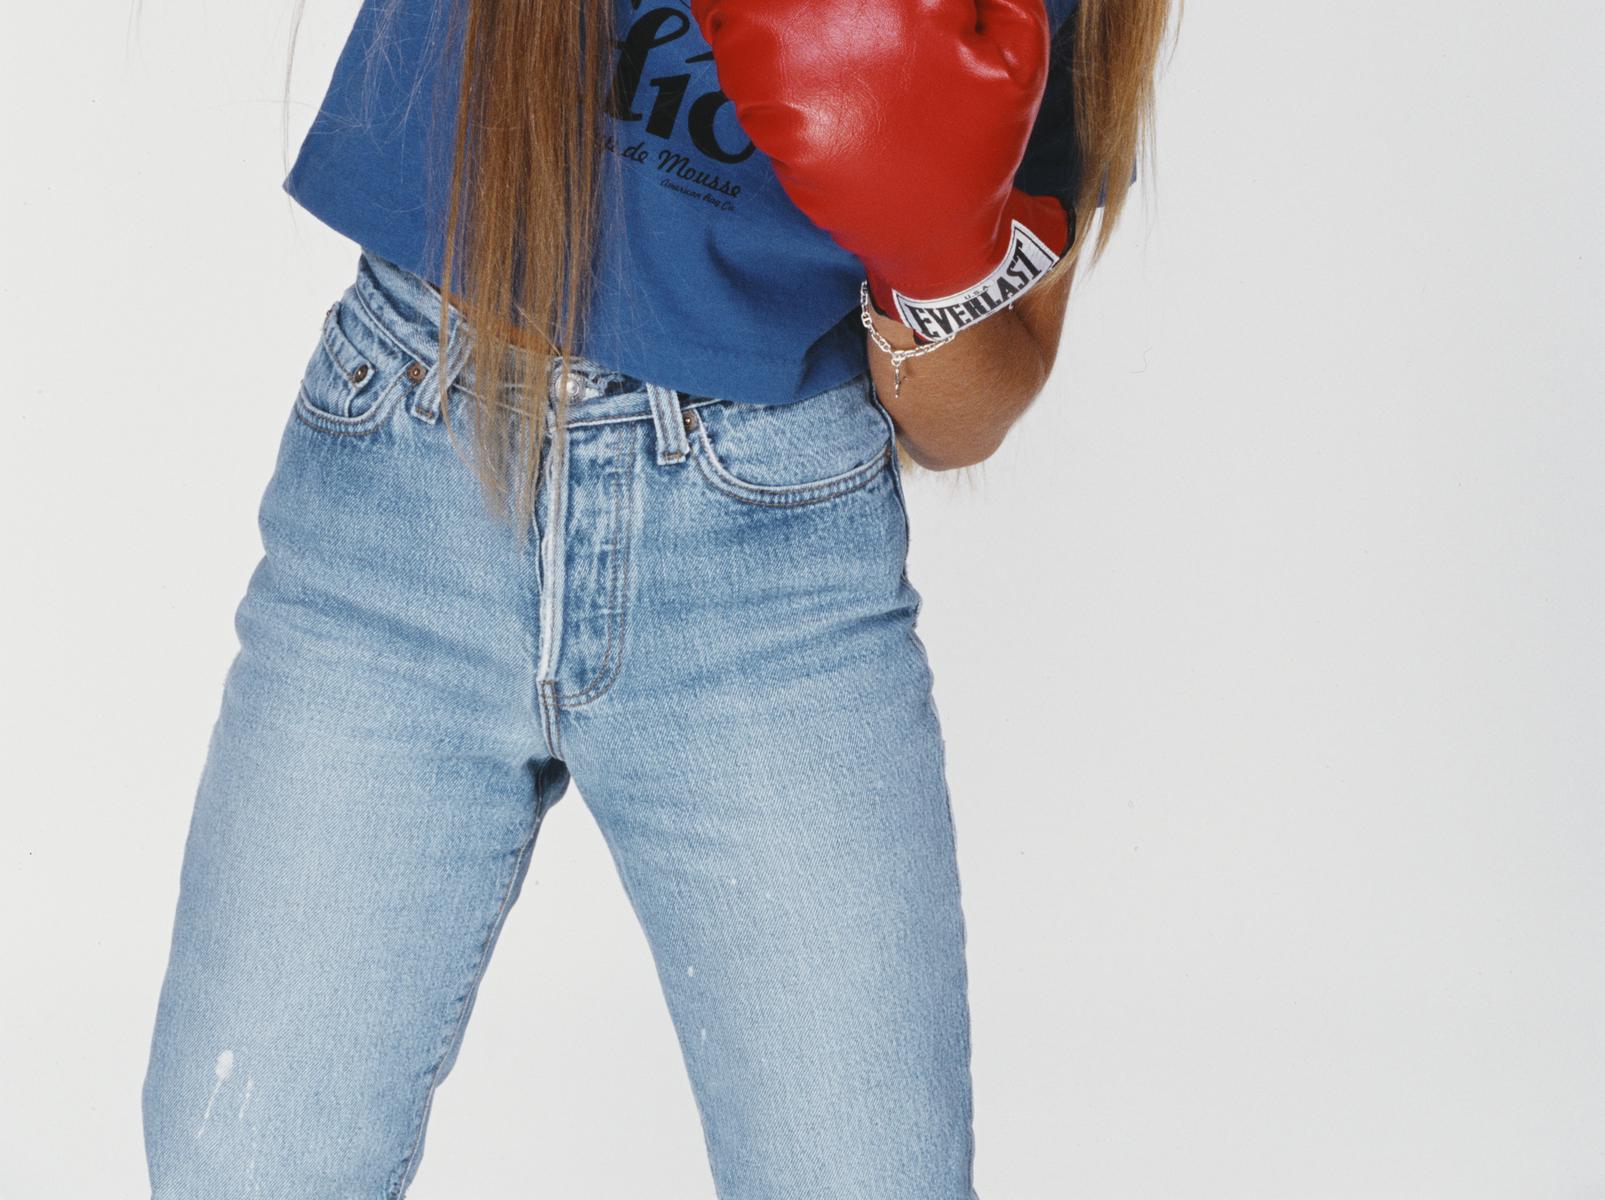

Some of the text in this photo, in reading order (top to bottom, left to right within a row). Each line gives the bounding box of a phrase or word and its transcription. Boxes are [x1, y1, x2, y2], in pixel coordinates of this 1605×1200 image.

[621, 141, 649, 164] de
[657, 150, 741, 197] Mousse
[904, 239, 1042, 338] EVERLAST
